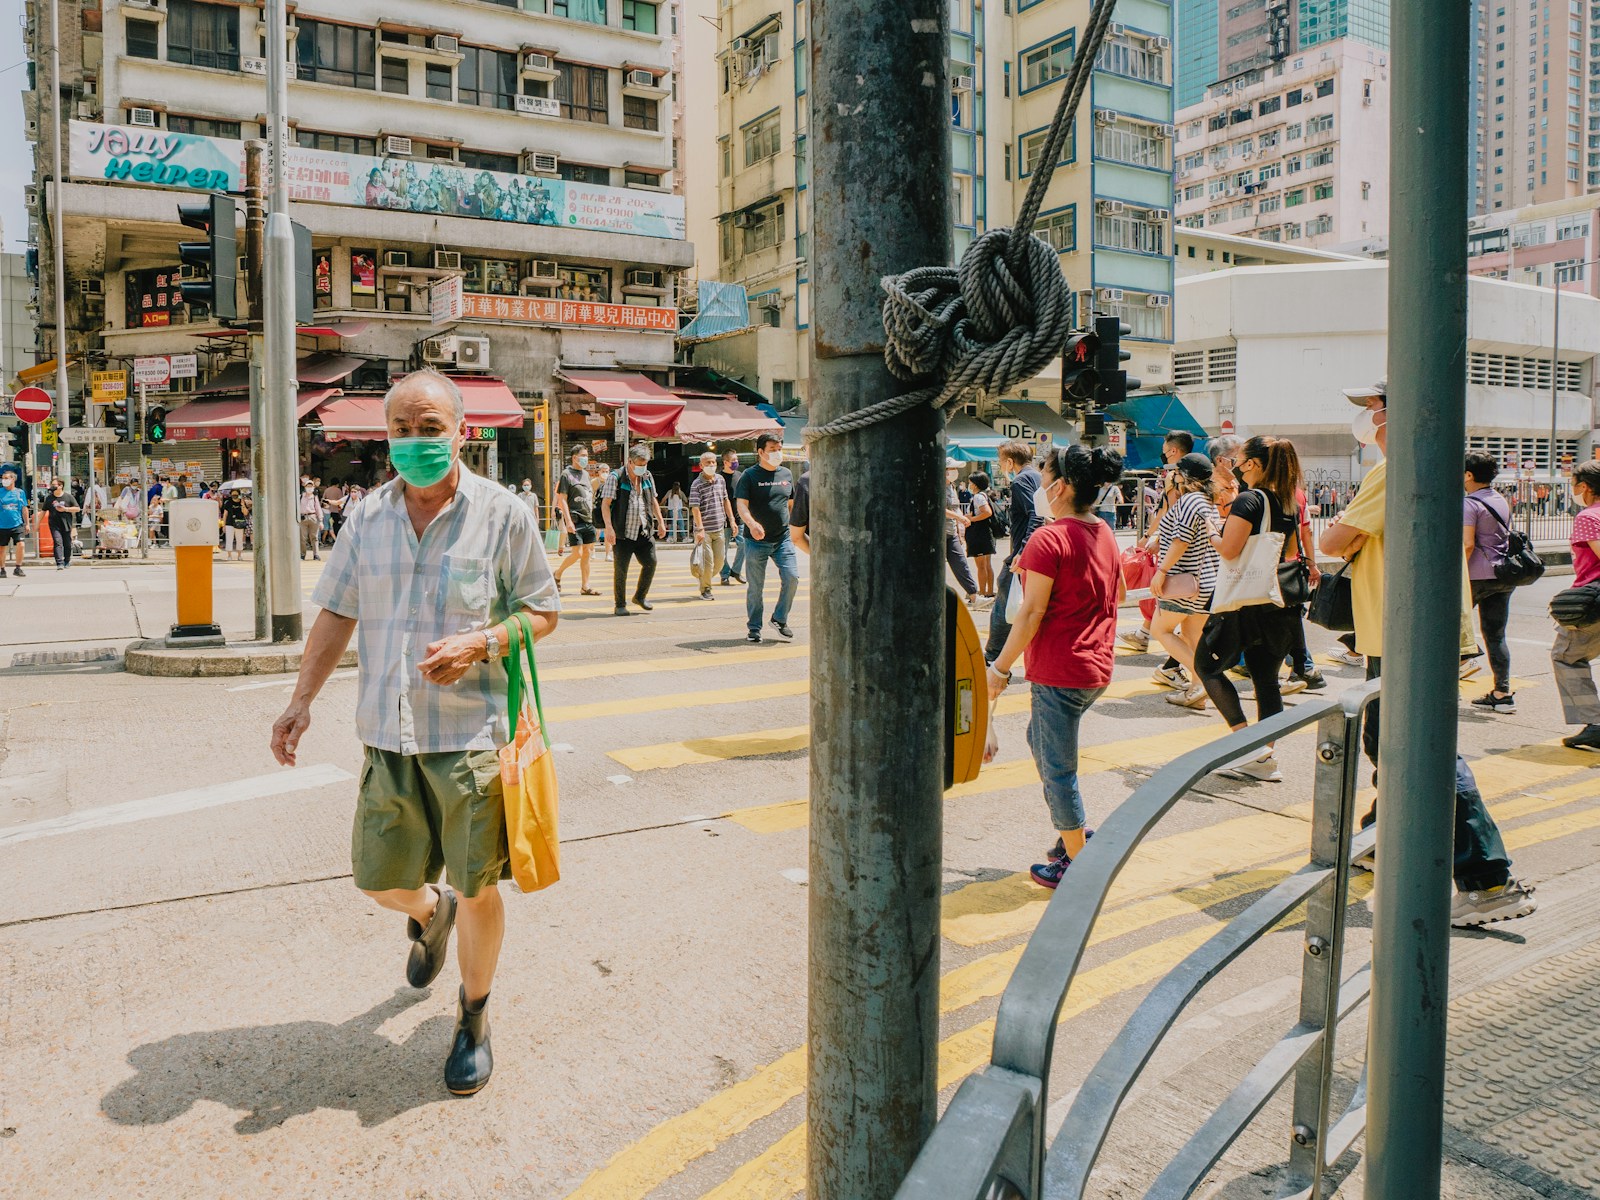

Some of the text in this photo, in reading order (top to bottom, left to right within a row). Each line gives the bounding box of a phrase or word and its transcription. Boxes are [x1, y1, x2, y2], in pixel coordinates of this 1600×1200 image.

[288, 155, 348, 166] yhelper.com
[462, 295, 557, 320] 新華物業代理
[564, 303, 674, 327] 新華嬰兒用品中心
[143, 314, 159, 323] 入口
[1003, 424, 1036, 439] IDE
